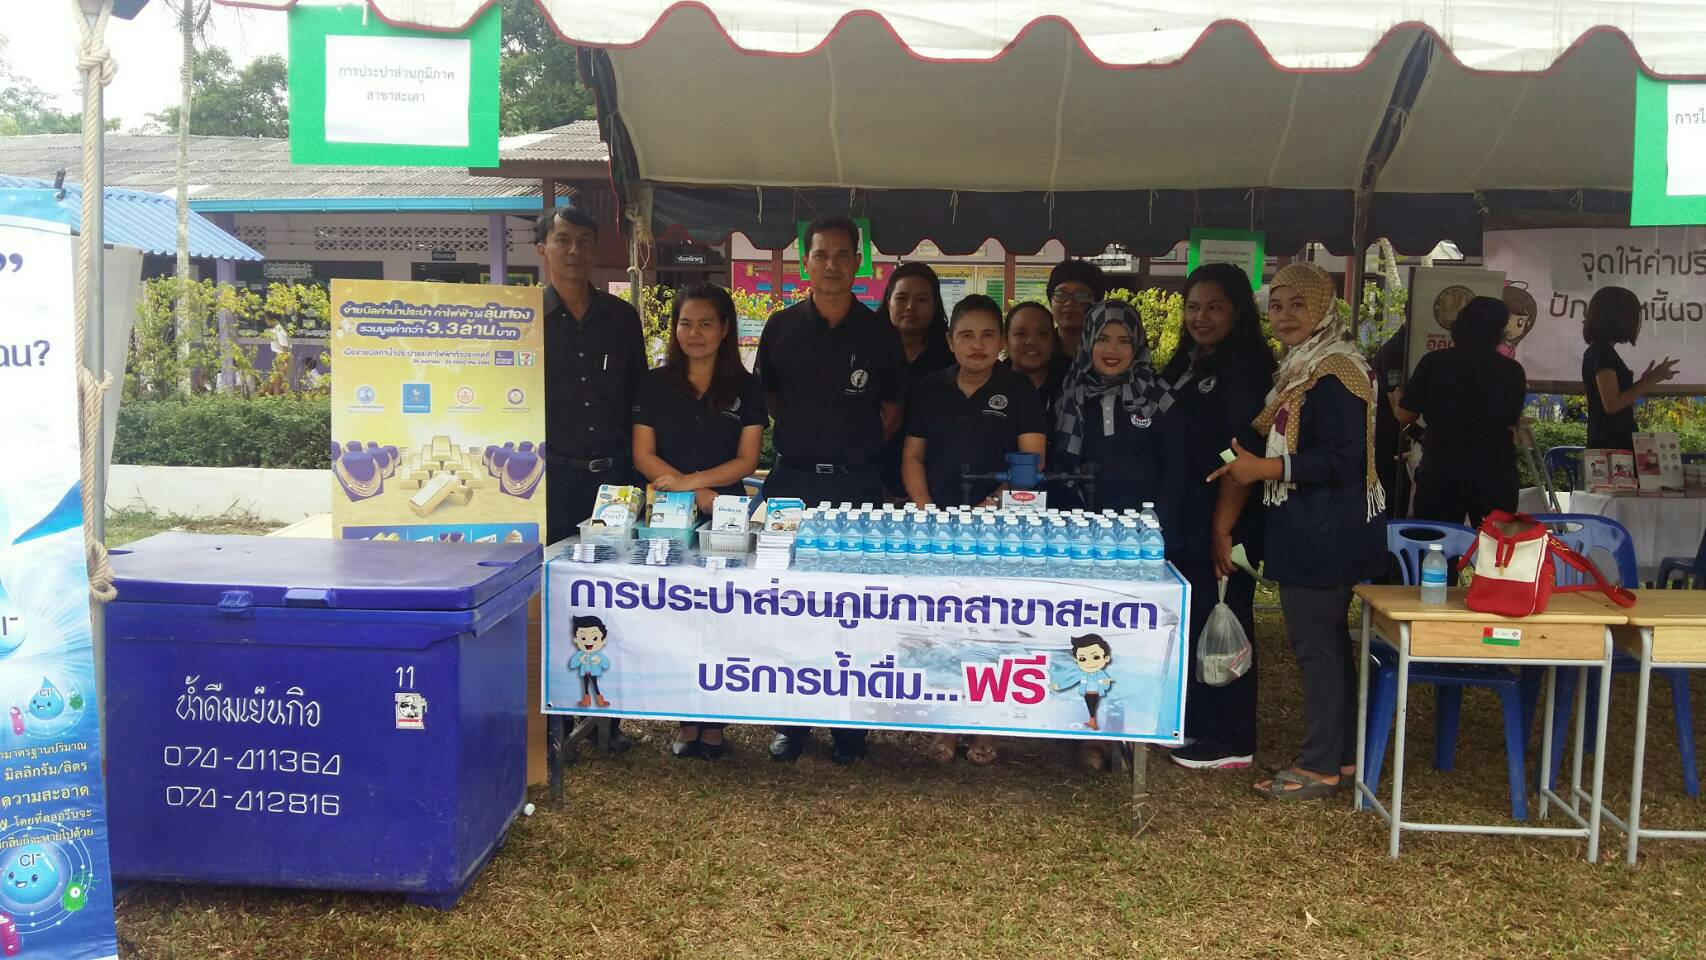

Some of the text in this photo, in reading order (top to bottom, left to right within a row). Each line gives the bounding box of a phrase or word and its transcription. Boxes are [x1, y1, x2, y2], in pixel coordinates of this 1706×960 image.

[339, 65, 455, 84] การประปาส่วนภูมิภาค
[367, 90, 425, 102] สาขาสะเดา
[570, 578, 1157, 630] การประปาส่วนภูมิภาคสาขาสะเดา
[395, 665, 414, 689] 11
[164, 746, 340, 776] 074-411364
[166, 786, 340, 816] 074-412816
